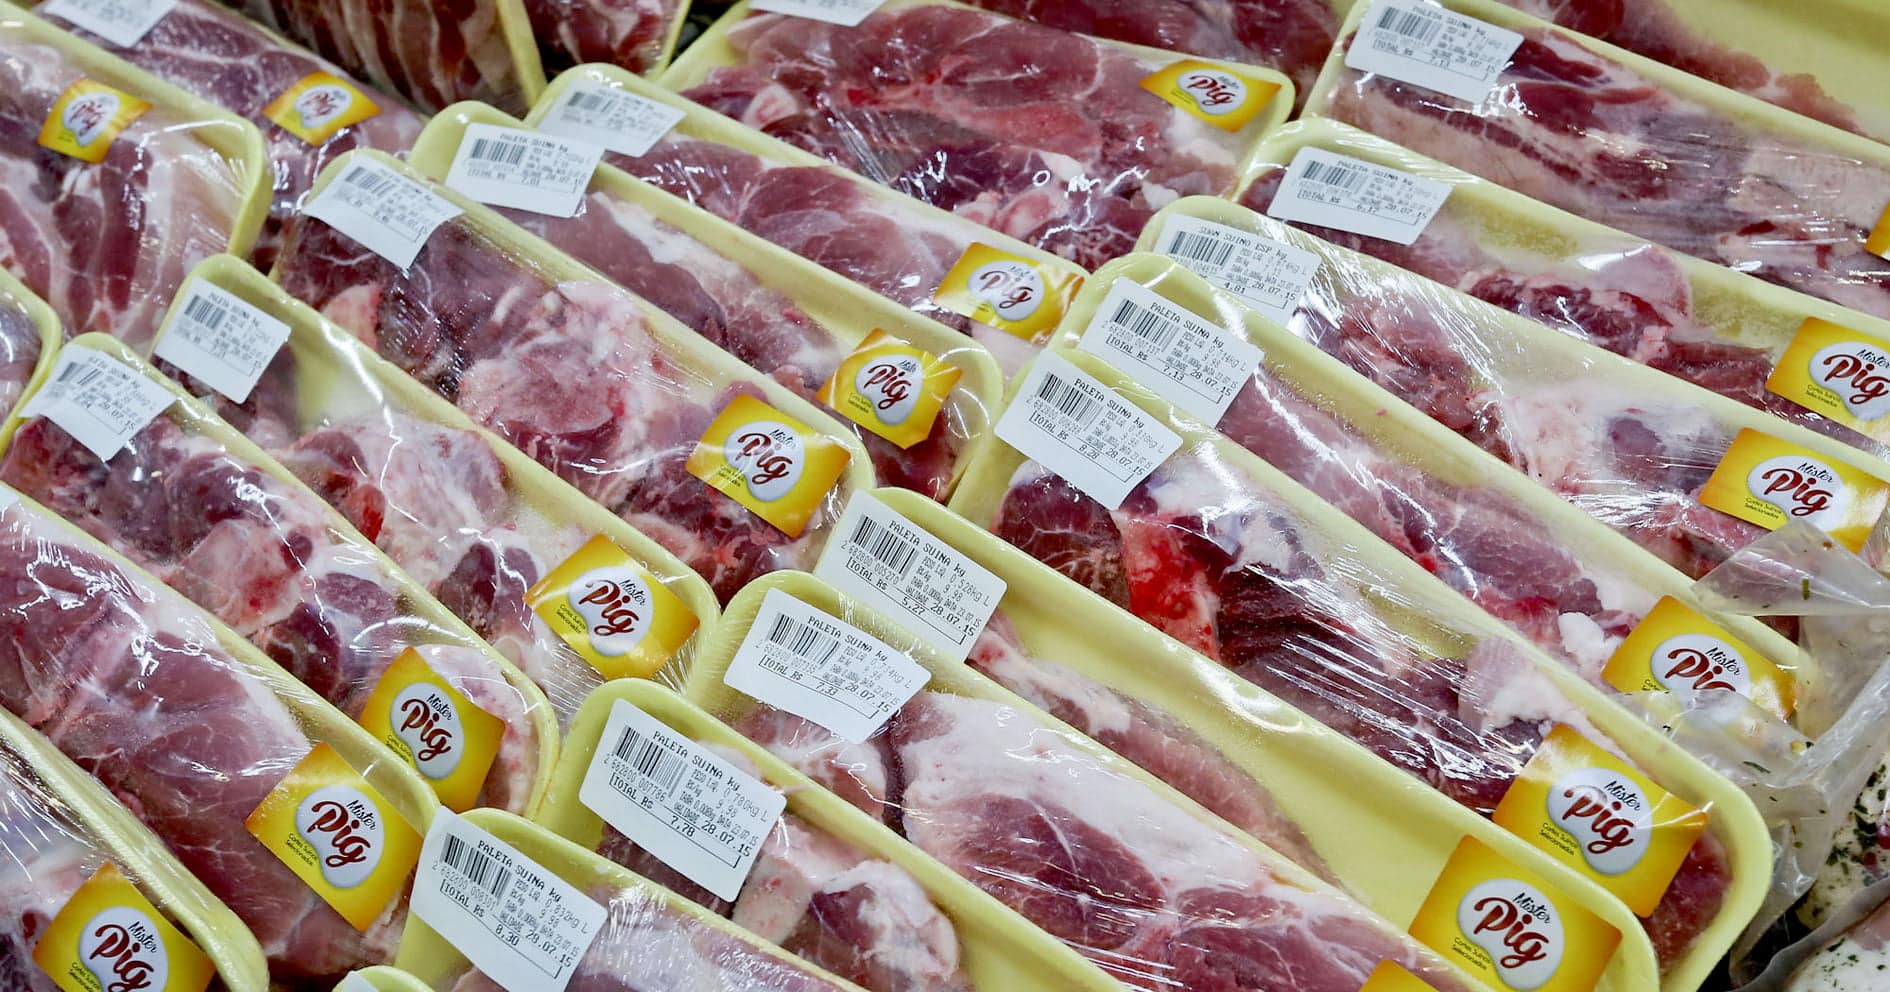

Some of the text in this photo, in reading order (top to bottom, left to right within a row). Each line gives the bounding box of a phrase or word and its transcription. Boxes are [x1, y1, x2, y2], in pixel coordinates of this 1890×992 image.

[1187, 75, 1235, 106] Pig
[1255, 243, 1272, 253] ESP
[979, 270, 1033, 309] Pig
[1252, 281, 1296, 301] 28.07.15
[1150, 302, 1224, 348] PALETA SUINA kg
[1109, 336, 1133, 355] TOTAL
[864, 364, 911, 410] Pig
[1190, 371, 1232, 397] 28.07.15
[1823, 354, 1890, 404] Pig
[1074, 378, 1145, 429] PALETA SUINA kg
[1033, 415, 1054, 432] TOTAL
[735, 433, 793, 485] Pig
[1106, 447, 1145, 476] 28.07.15
[1797, 462, 1833, 483] Mister
[1761, 468, 1834, 517] Pig
[889, 521, 966, 577] PALETA SUINA kg
[850, 560, 872, 582] TOTAL
[578, 579, 639, 636] Pig
[620, 579, 646, 605] Mister
[930, 604, 975, 636] 28.07.15
[808, 616, 888, 661] PALETA SUINA kg
[763, 657, 788, 675] TOTAL
[1705, 647, 1740, 676] Mister
[427, 694, 452, 720] Mister
[845, 682, 890, 713] 28.07.15
[401, 699, 452, 761] Pig
[653, 731, 740, 792] PALETA SUINA kg
[613, 774, 637, 799] TOTAL
[1604, 780, 1641, 811] Mister
[346, 800, 376, 831] Mister
[1562, 785, 1635, 854] Pig
[307, 801, 371, 868] Pig
[701, 820, 751, 857] 28.07.15
[478, 840, 562, 902] PALETA SUINA kg
[444, 883, 469, 907] TOTAL
[1512, 892, 1551, 923] Mister
[128, 921, 157, 953] Mister
[525, 929, 572, 967] 28.07.15
[1473, 897, 1549, 969] Pig
[89, 924, 154, 992] Pig
